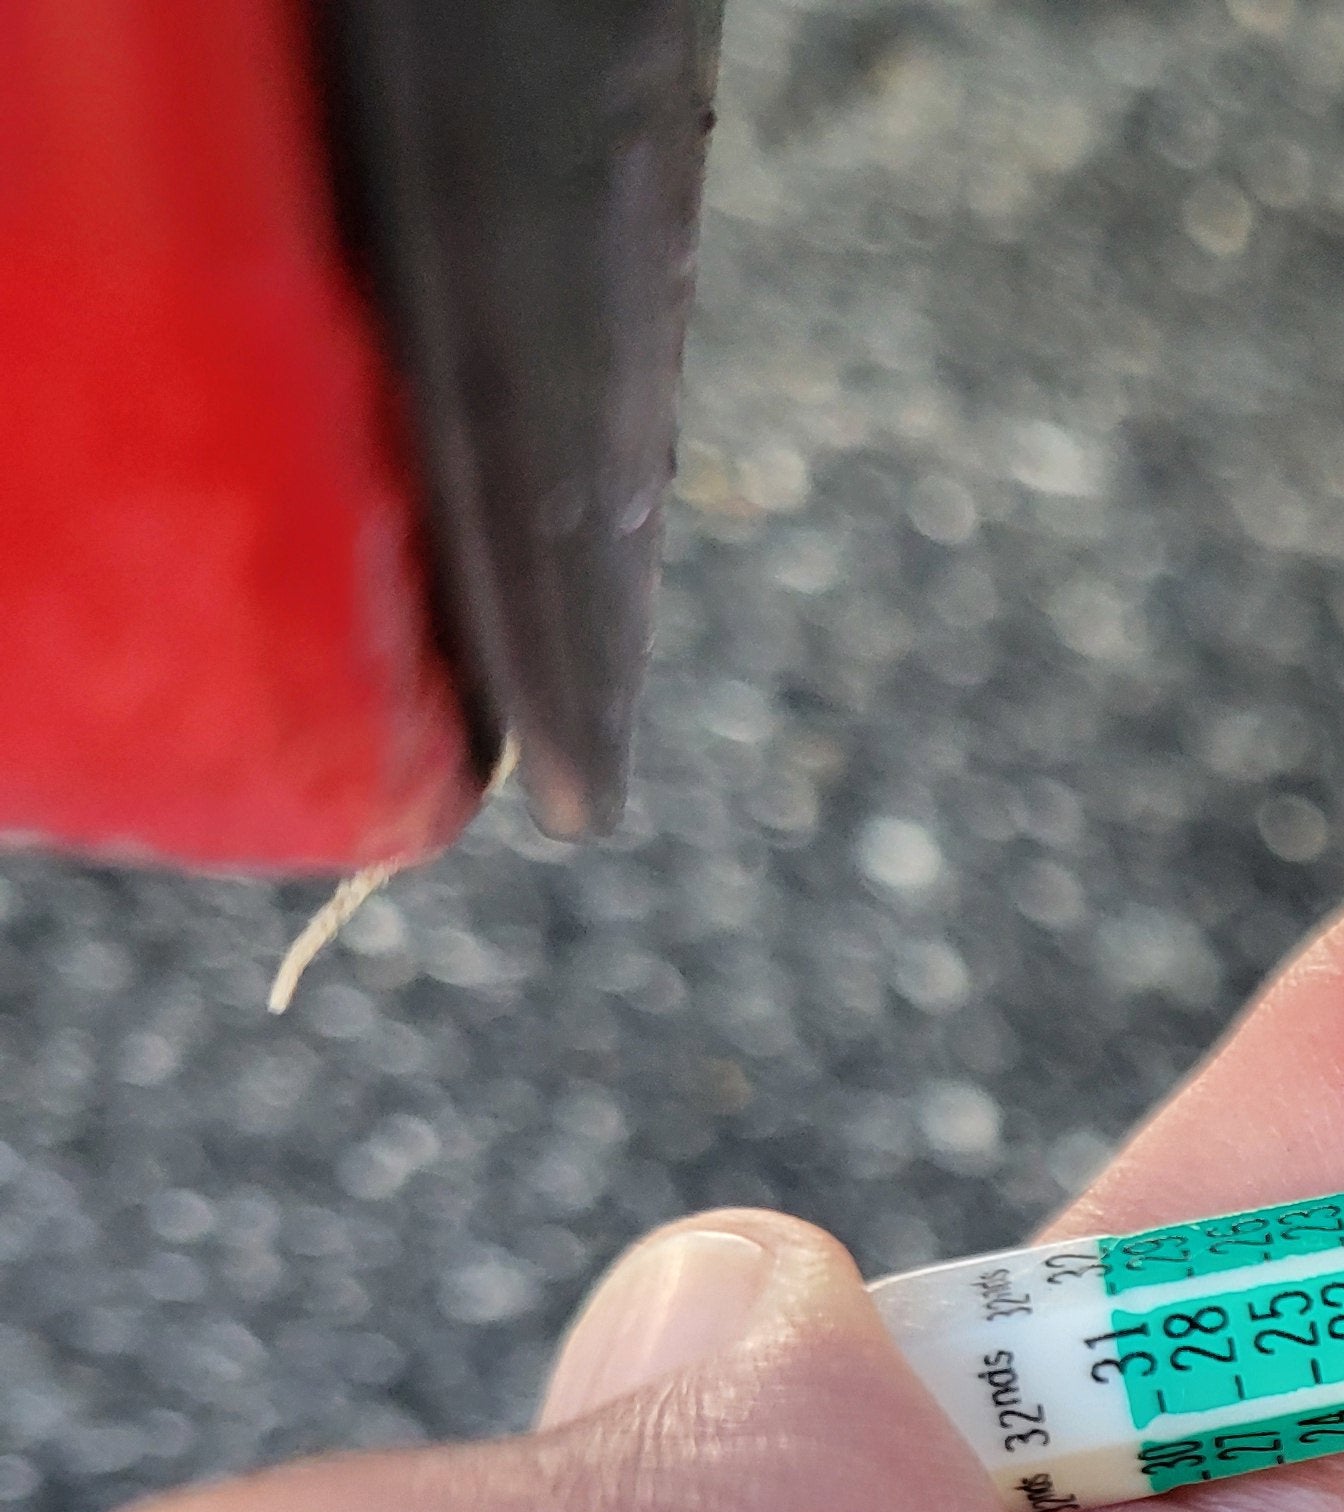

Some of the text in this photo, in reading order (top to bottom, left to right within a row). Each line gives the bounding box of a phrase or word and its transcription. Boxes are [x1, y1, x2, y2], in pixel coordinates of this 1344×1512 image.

[1122, 1234, 1192, 1271] 29
[1206, 1218, 1273, 1254] 26
[1045, 1245, 1113, 1285] 32
[1163, 1306, 1236, 1371] 28
[1248, 1290, 1319, 1355] 25
[1084, 1322, 1157, 1384] 31
[978, 1350, 1050, 1452] 32nds
[1137, 1440, 1206, 1475] 30
[1213, 1431, 1282, 1460] 27
